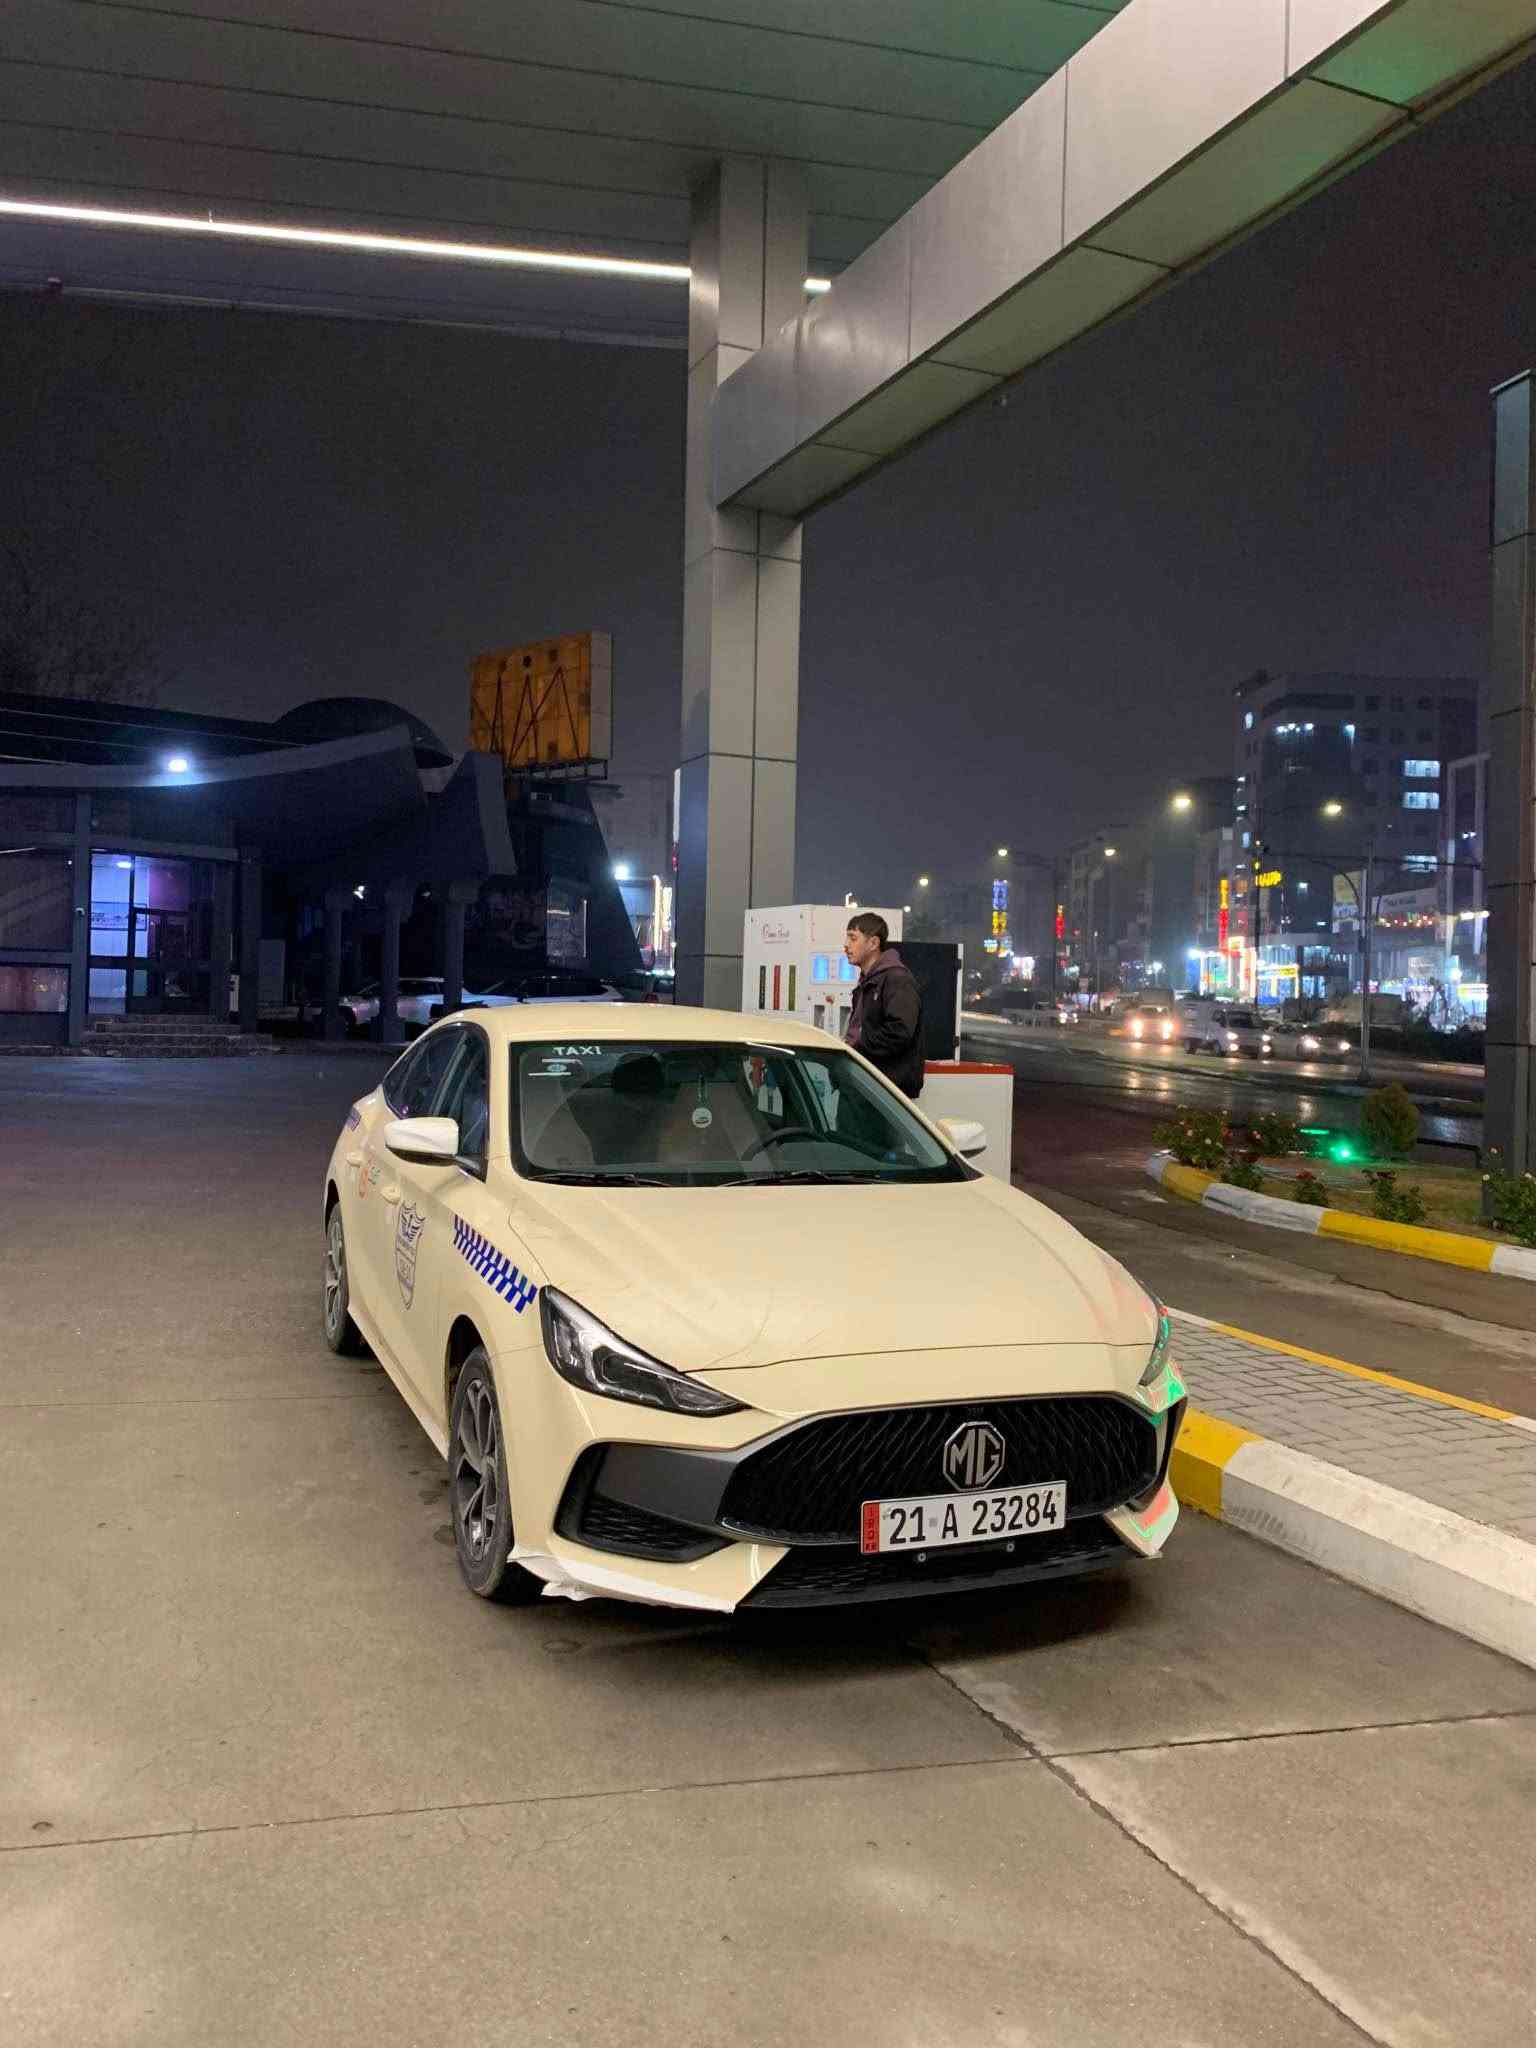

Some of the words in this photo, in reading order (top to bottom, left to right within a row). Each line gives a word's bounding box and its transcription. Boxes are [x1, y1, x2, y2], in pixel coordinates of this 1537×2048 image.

[553, 1045, 602, 1056] TAXI
[949, 1428, 1001, 1486] MG
[889, 1506, 926, 1545] 21
[942, 1503, 959, 1540] A
[971, 1490, 1058, 1536] 23284
